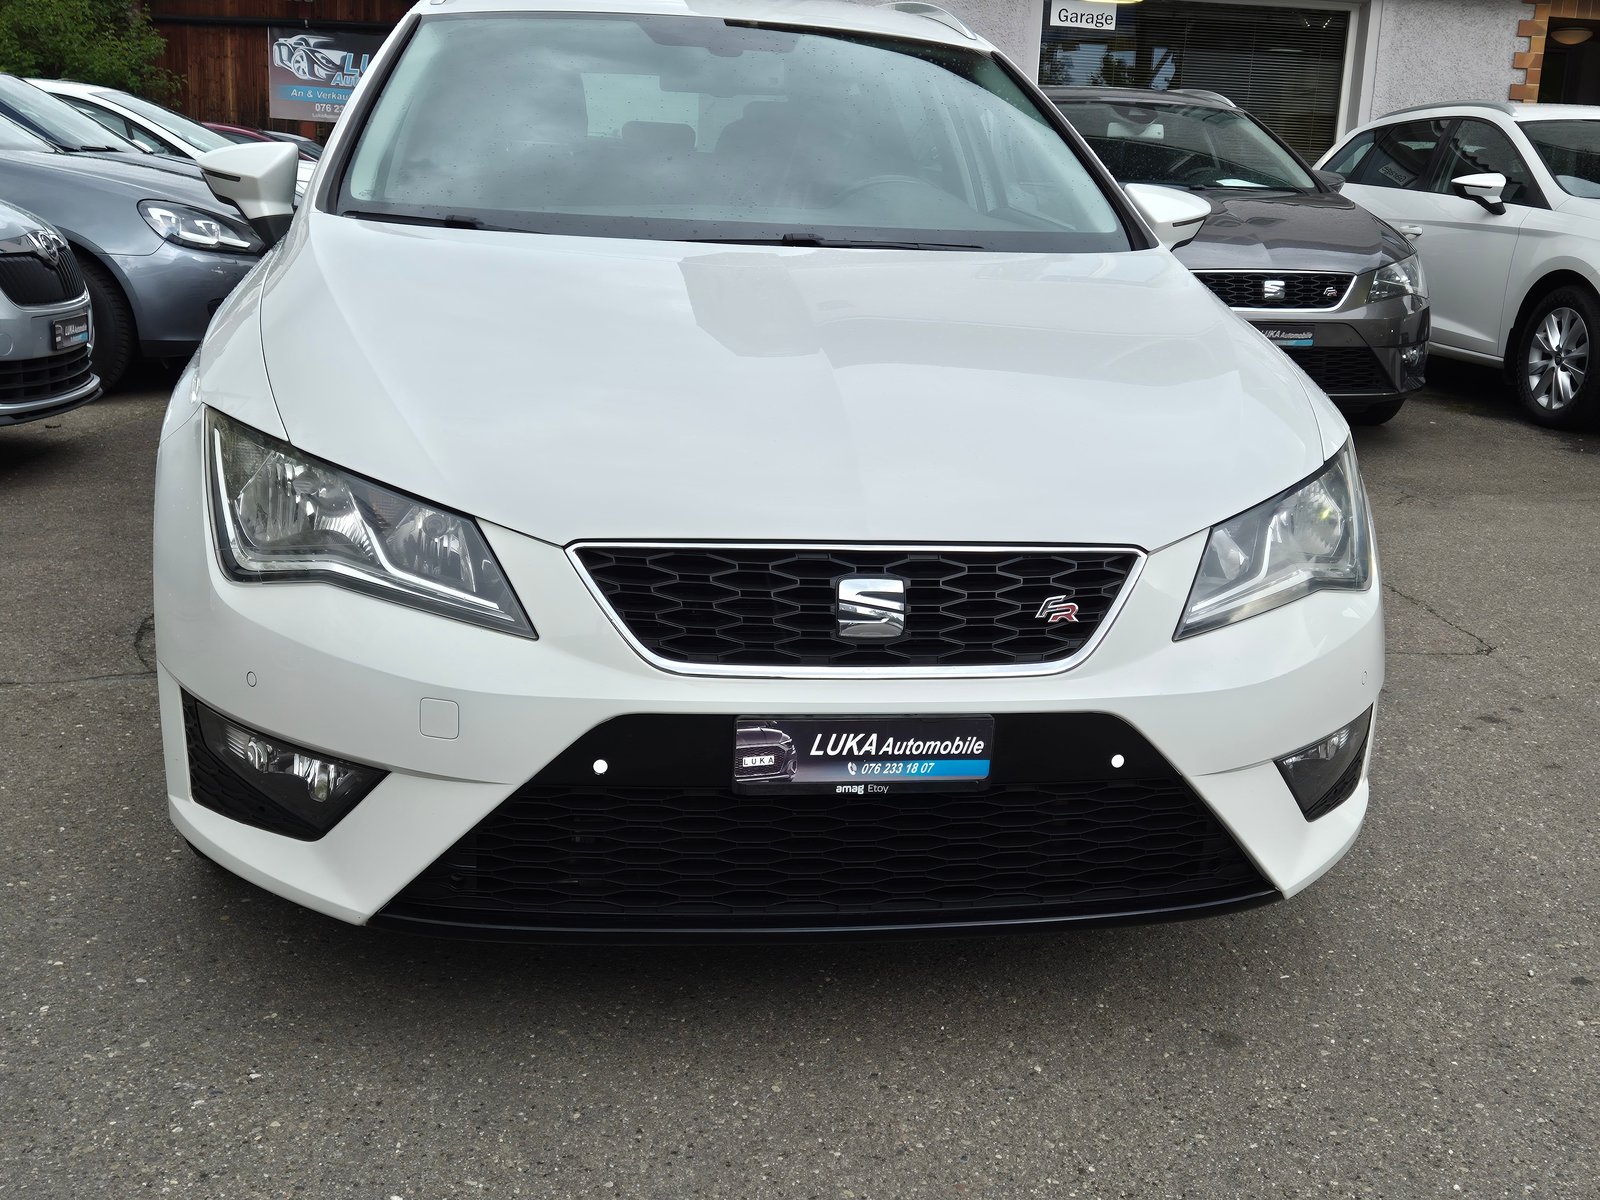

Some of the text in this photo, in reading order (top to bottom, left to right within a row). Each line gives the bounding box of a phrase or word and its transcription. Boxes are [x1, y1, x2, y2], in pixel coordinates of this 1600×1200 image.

[1058, 8, 1113, 28] Garage
[291, 89, 351, 101] An & Verkau
[315, 103, 331, 113] 076
[1262, 330, 1280, 338] UKA
[1035, 595, 1079, 623] FR
[810, 733, 985, 756] LUKA Automobile
[861, 762, 935, 774] 076 233 18 07
[836, 784, 889, 795] amag Etoy
